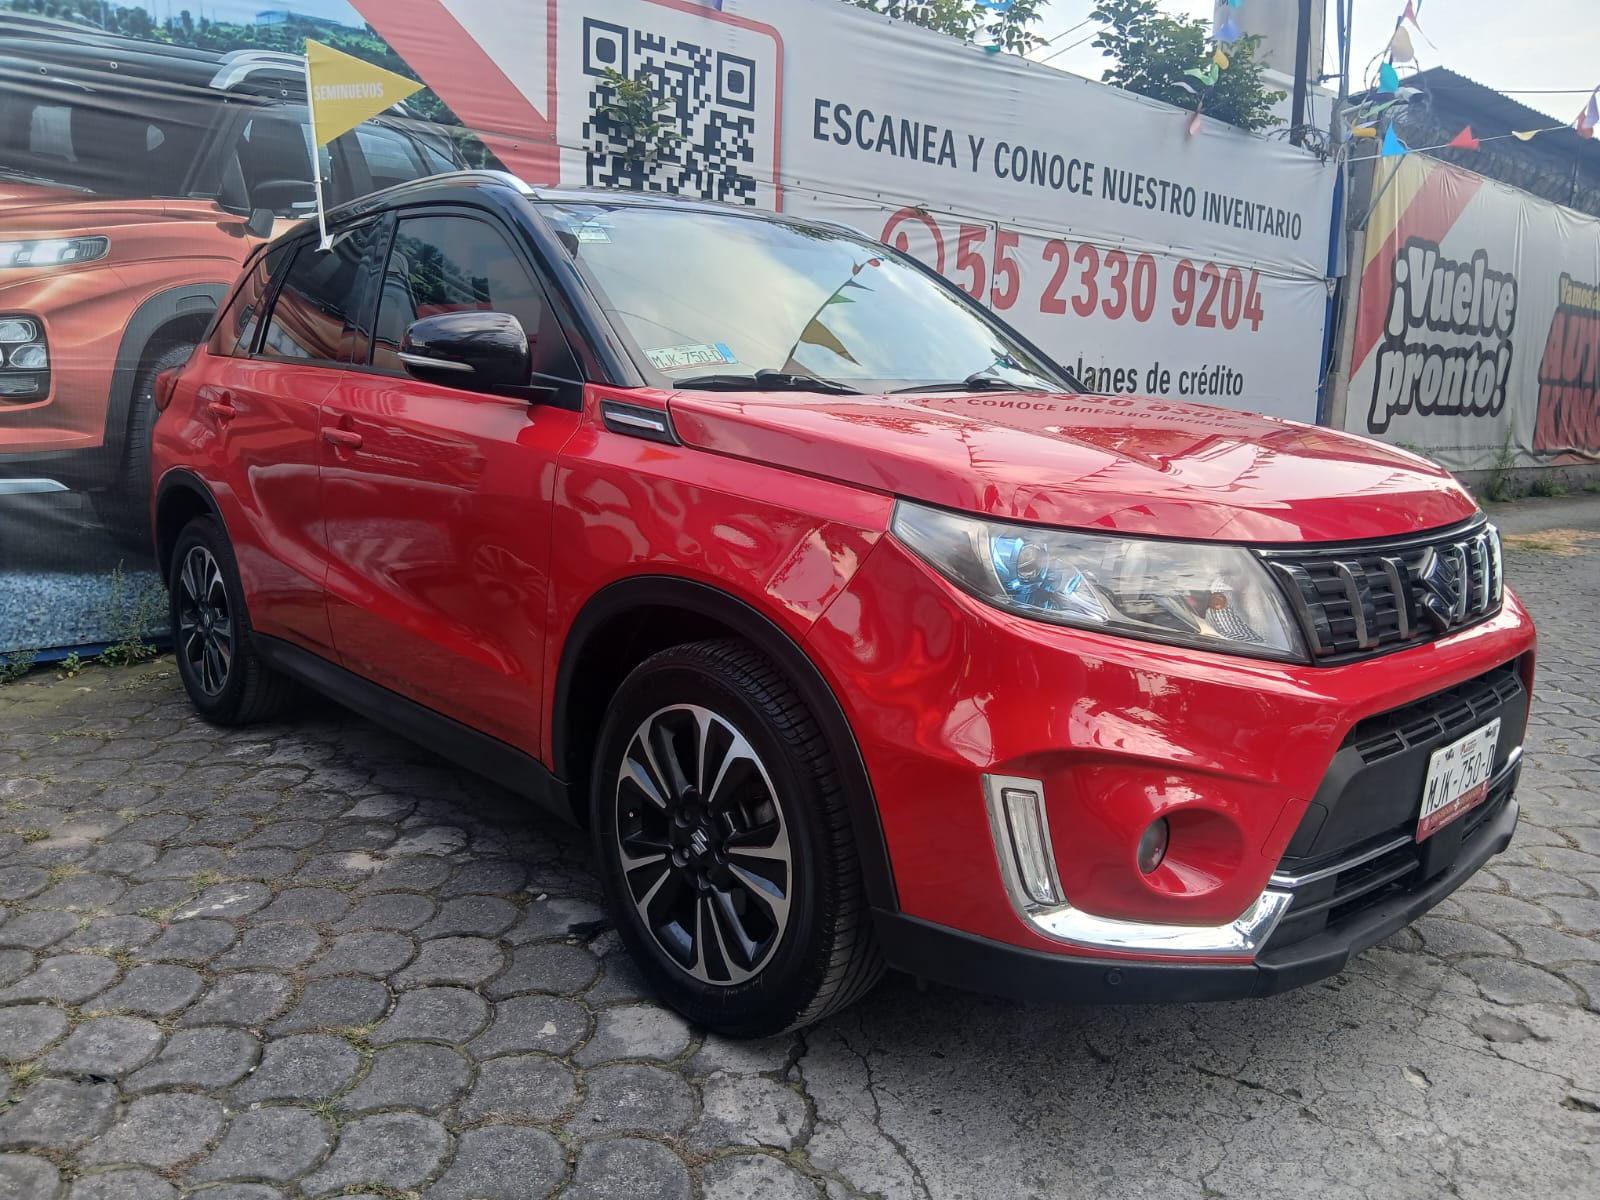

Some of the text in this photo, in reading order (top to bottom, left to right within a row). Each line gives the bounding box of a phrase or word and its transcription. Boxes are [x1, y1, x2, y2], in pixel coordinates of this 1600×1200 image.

[314, 82, 384, 100] SEMINUEVOS
[813, 97, 1302, 241] ESCANEA Y CONOCE NUESTRO INVENTARIO
[956, 224, 1264, 332] 55 2330 9204
[1387, 244, 1515, 338] ¡Vuelve
[1146, 361, 1171, 395] de
[1178, 364, 1244, 396] crédito
[1371, 346, 1512, 425] pronto!
